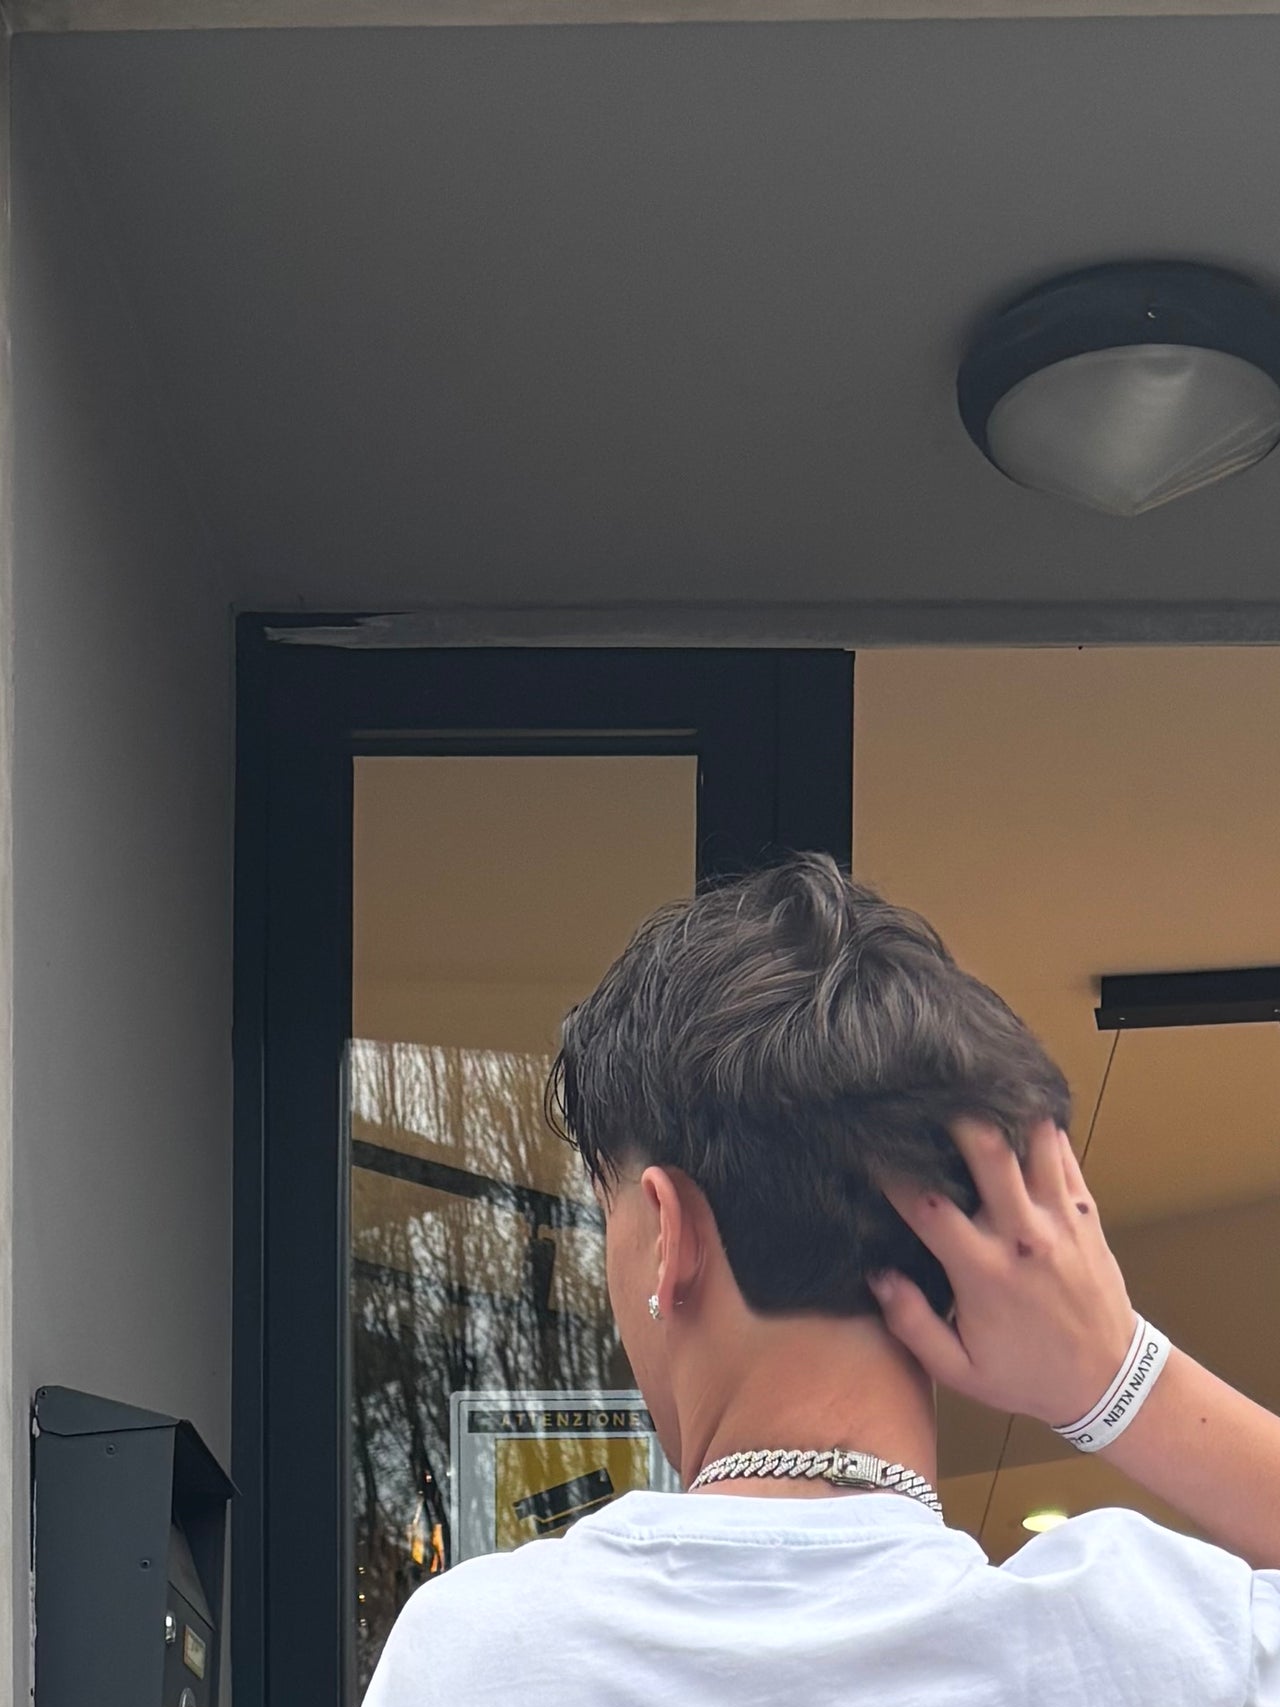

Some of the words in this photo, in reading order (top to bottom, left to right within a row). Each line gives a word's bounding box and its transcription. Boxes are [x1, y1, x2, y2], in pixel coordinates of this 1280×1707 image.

[1129, 1341, 1159, 1391] CALVIN
[500, 1412, 641, 1427] ATTENZIONE
[1103, 1389, 1135, 1427] KLEIN
